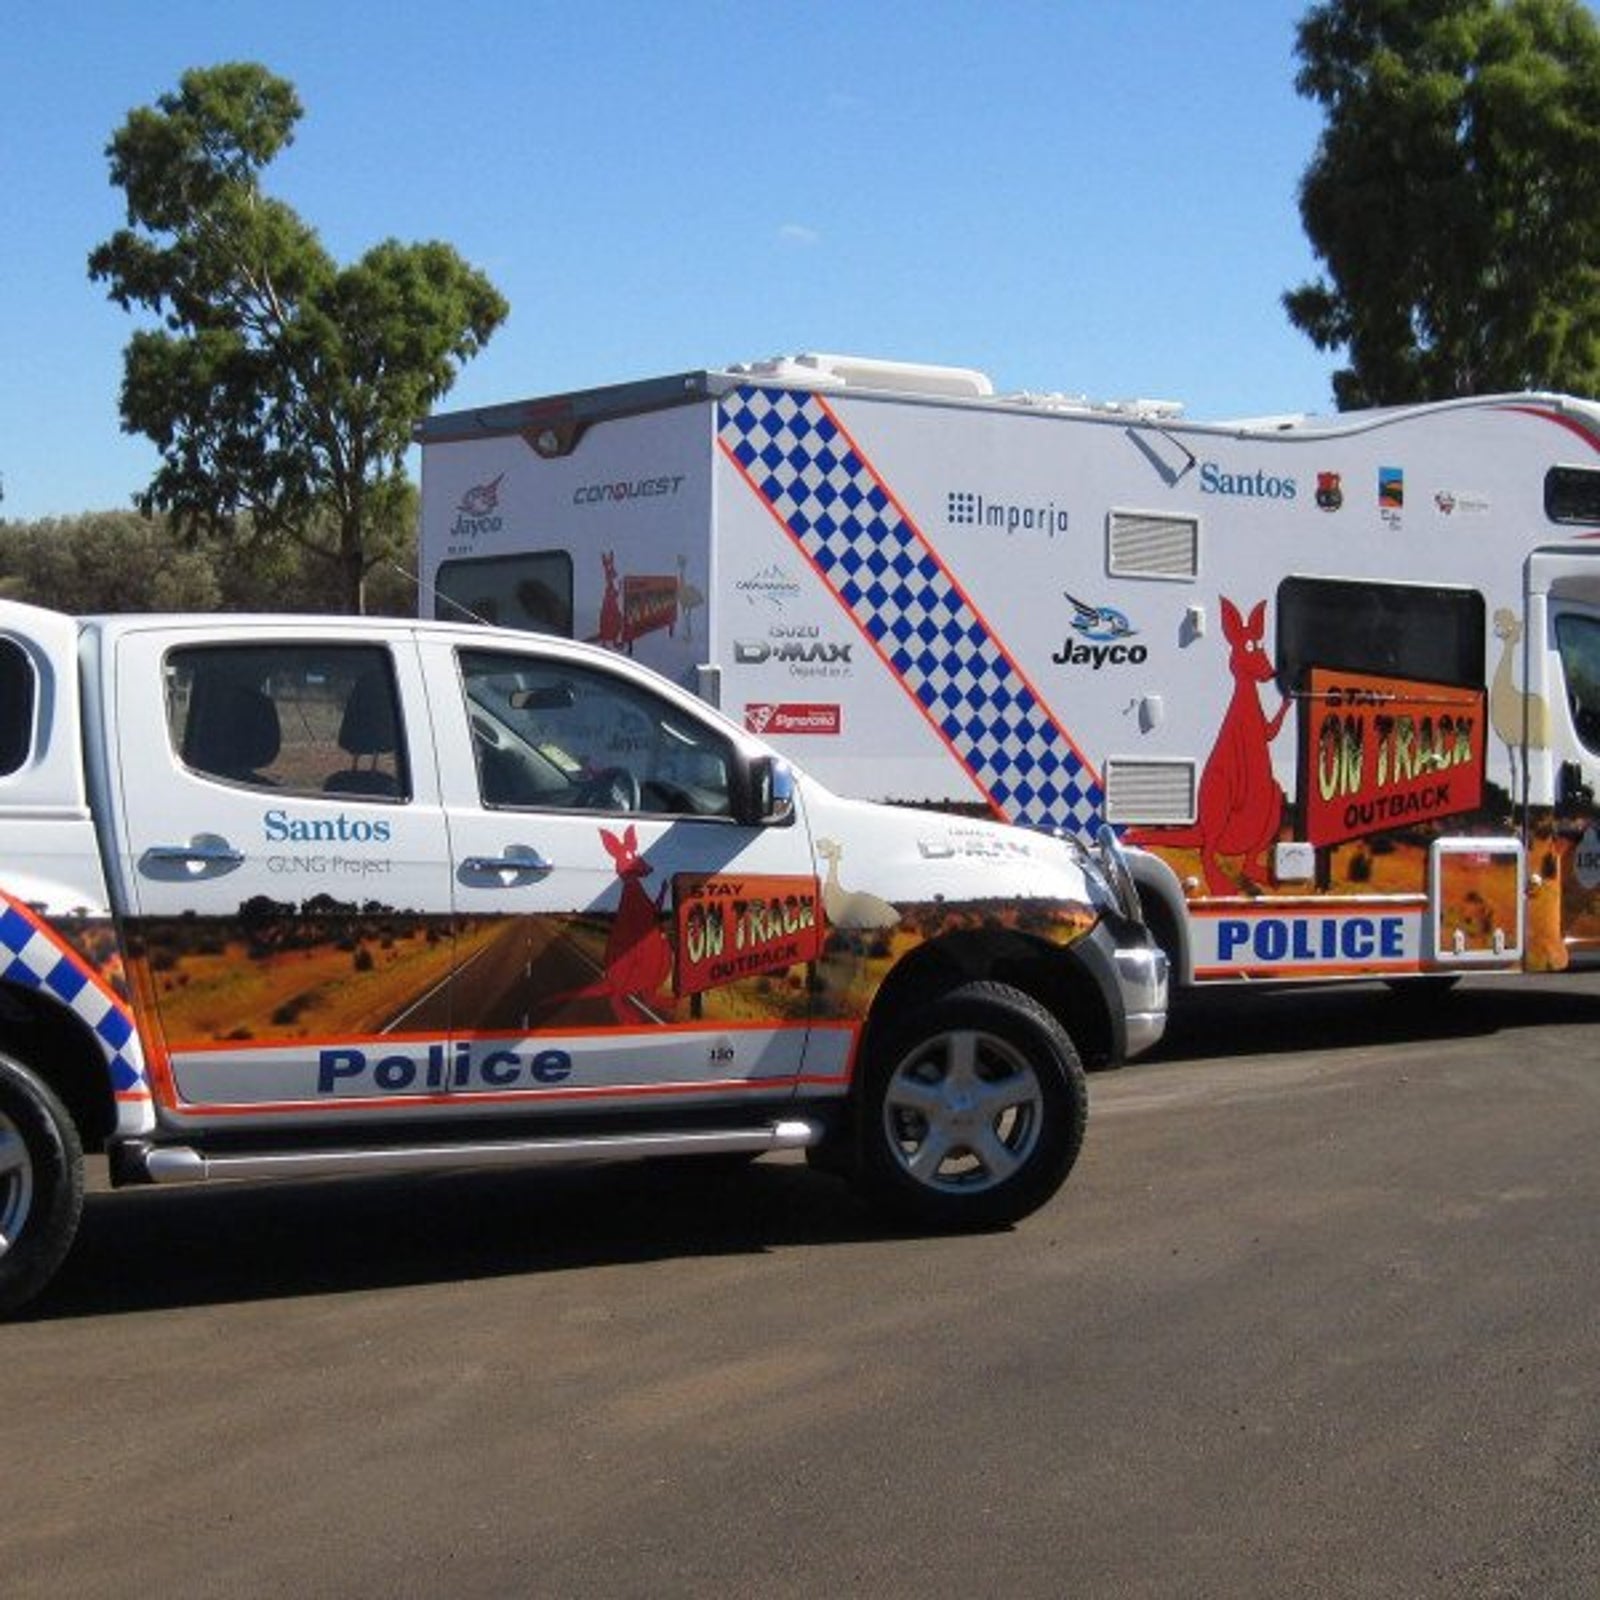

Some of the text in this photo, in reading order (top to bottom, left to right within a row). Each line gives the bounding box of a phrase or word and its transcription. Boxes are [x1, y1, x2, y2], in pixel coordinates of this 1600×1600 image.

[1199, 462, 1297, 500] Santos
[451, 514, 504, 538] Jayco
[1052, 637, 1148, 670] Jayco
[1318, 713, 1474, 803] ON TRACK
[263, 809, 391, 842] Santos
[1343, 784, 1450, 830] OUTBACK
[332, 855, 391, 878] Project
[690, 882, 744, 898] STAY
[687, 895, 816, 965] ON TRACK
[1217, 917, 1405, 961] POLICE
[708, 942, 798, 979] OUTBACK
[317, 1043, 572, 1094] Police
